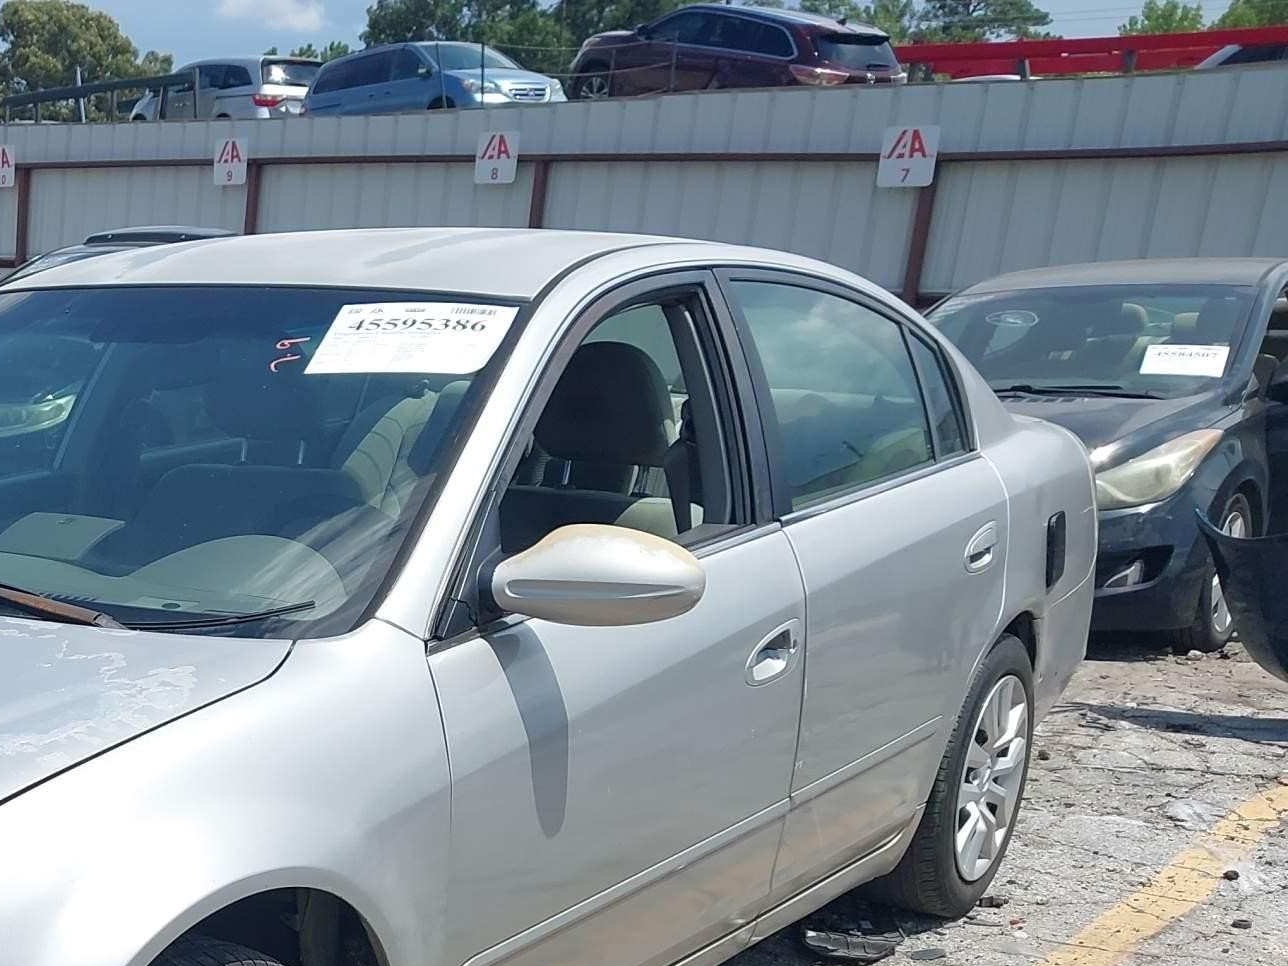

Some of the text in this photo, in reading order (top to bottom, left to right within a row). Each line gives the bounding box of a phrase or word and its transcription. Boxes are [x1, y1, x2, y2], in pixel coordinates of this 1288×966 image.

[226, 170, 233, 182] 9
[490, 167, 499, 180] 8
[900, 167, 911, 183] 7
[347, 317, 487, 332] 45595386
